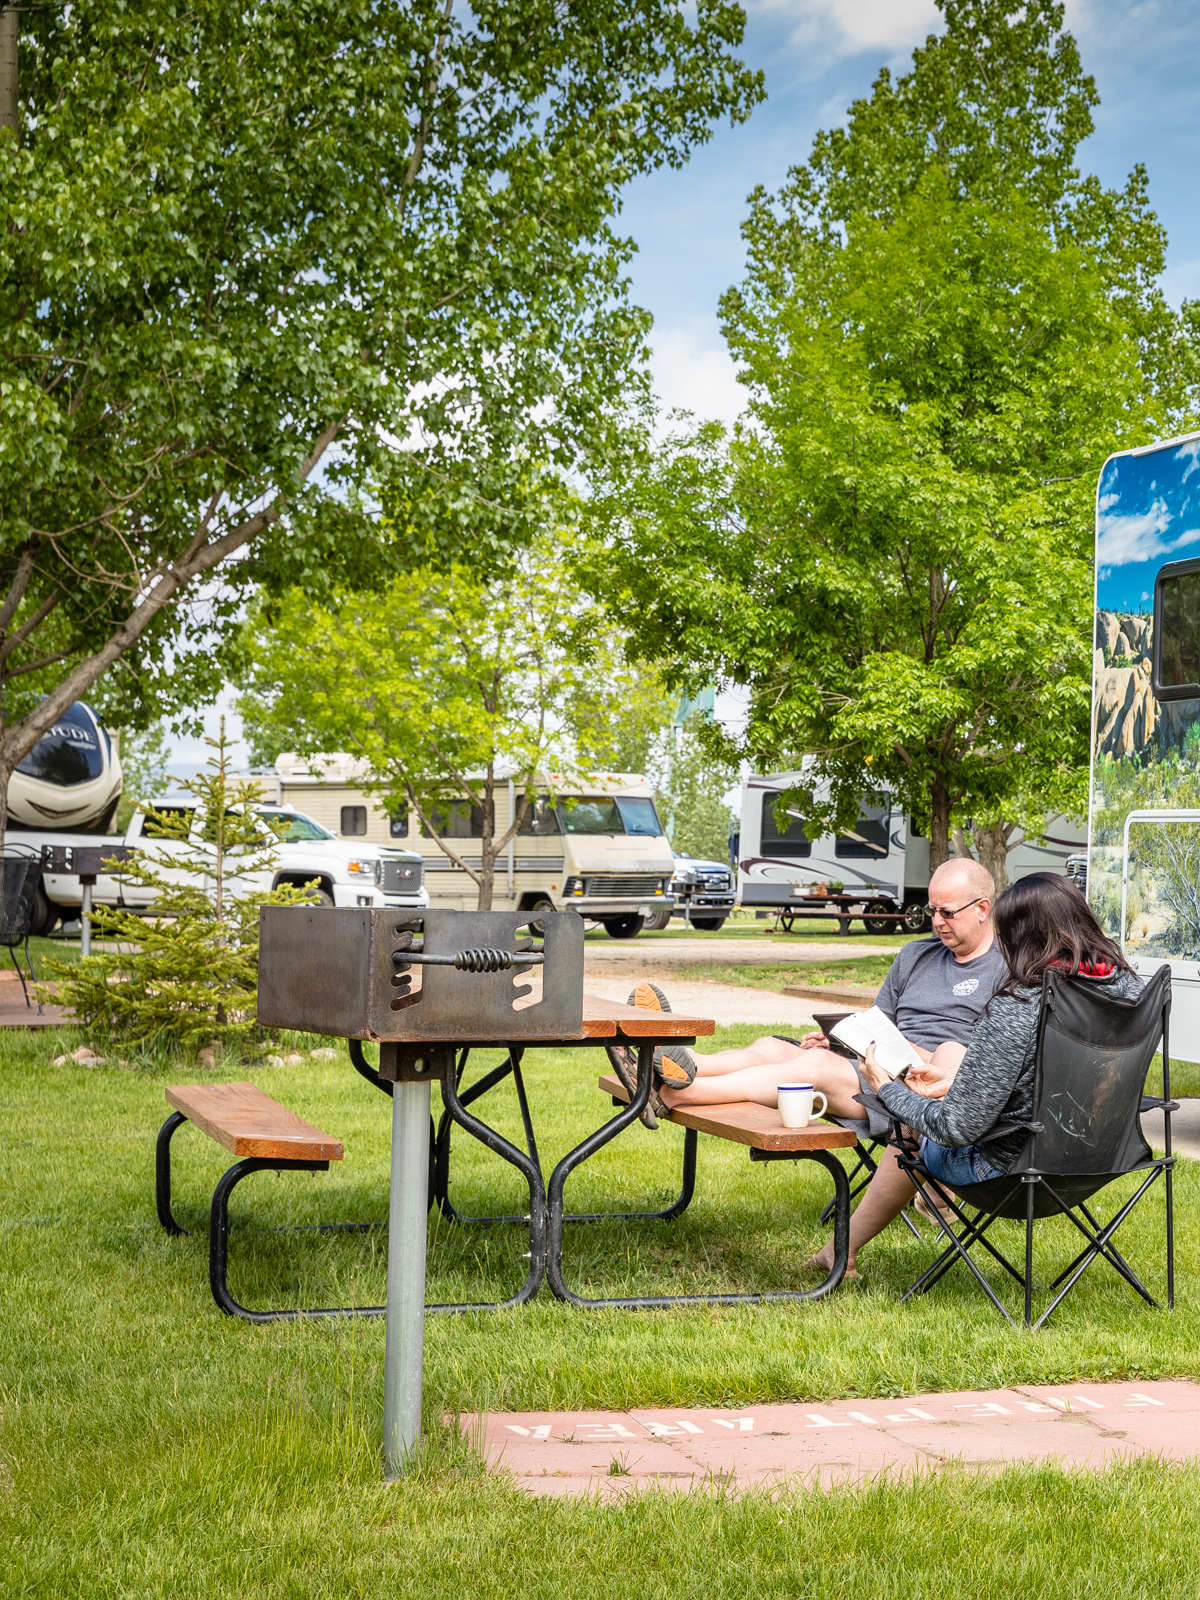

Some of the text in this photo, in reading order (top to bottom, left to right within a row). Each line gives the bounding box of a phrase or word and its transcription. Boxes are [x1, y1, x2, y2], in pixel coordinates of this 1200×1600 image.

[505, 1393, 1167, 1439] FIRE PIT AREA
